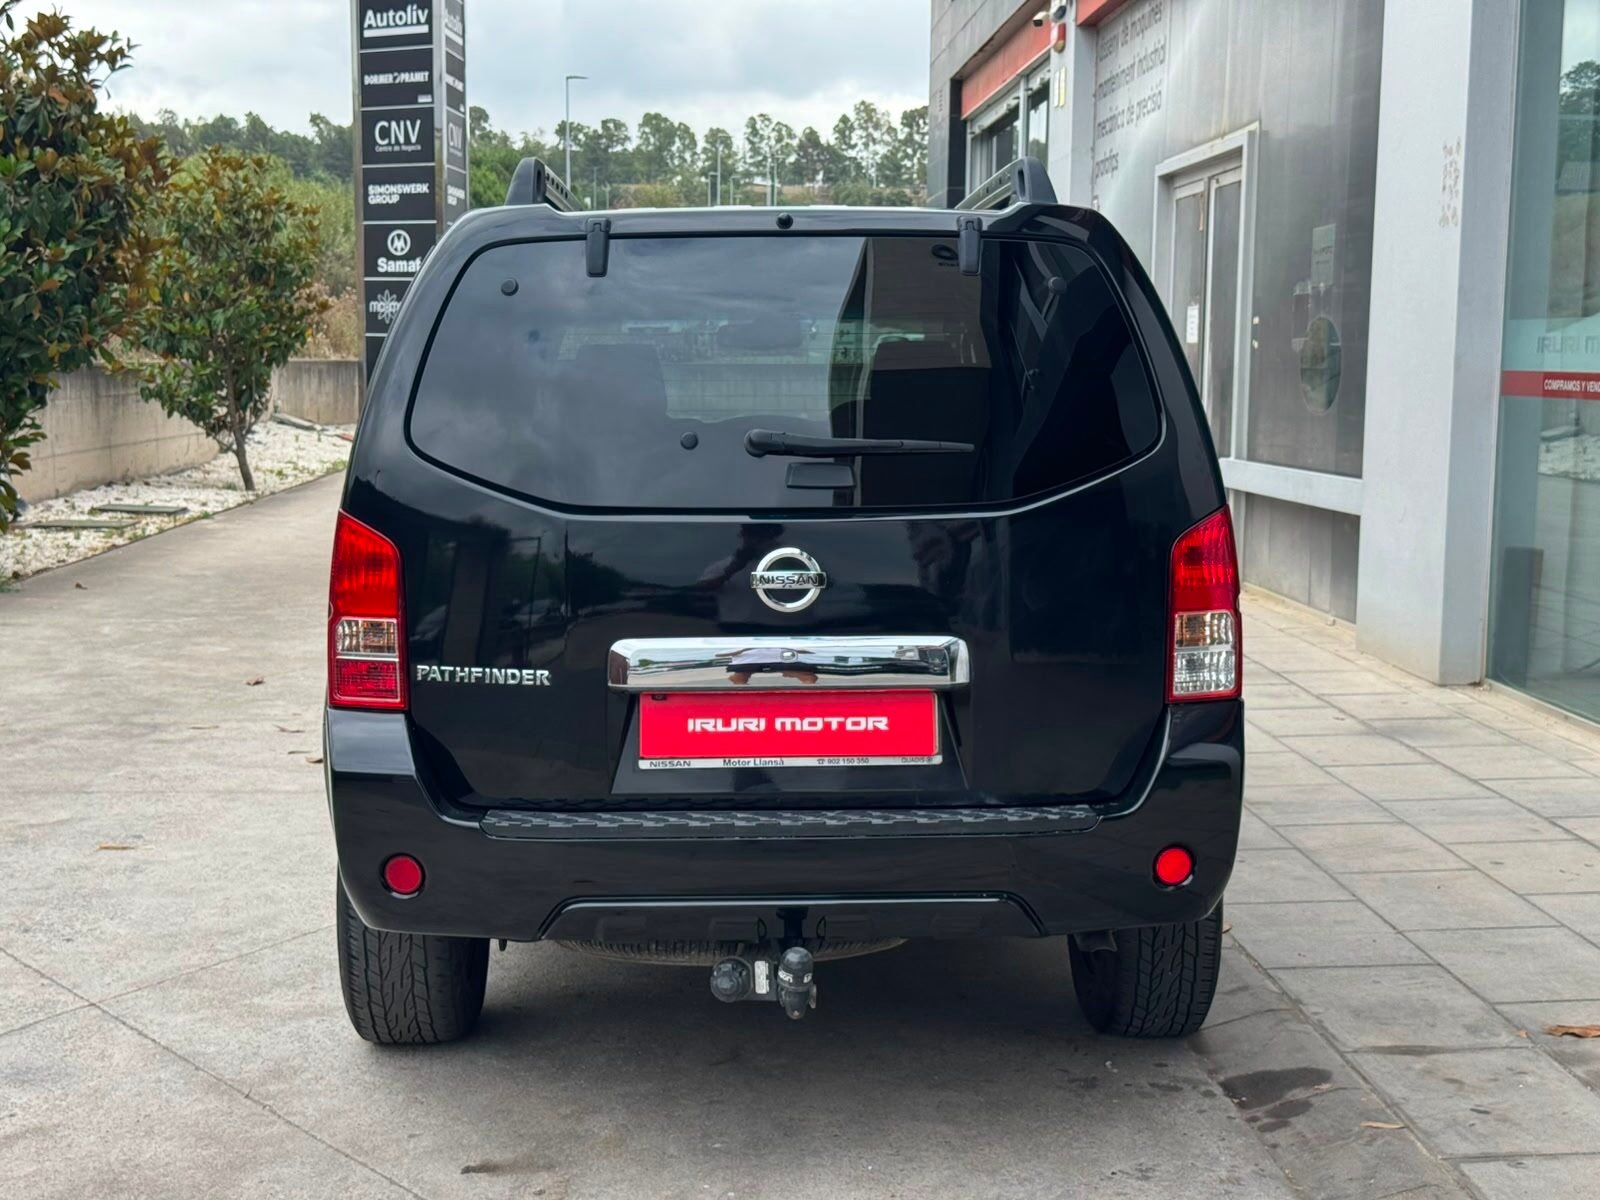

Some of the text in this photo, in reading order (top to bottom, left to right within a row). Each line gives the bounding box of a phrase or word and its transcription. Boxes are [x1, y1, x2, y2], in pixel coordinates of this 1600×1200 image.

[363, 4, 429, 28] Autoliv
[374, 119, 421, 145] CNV
[368, 183, 430, 195] SIMONSWERK
[368, 194, 400, 205] GROUP
[1543, 379, 1581, 392] COMPRAMOS
[760, 574, 817, 586] NISSAN
[416, 664, 550, 686] PATHFINDER
[687, 716, 890, 732] IRURI MOTOR
[649, 760, 691, 768] NISSAN
[723, 758, 751, 767] Motor
